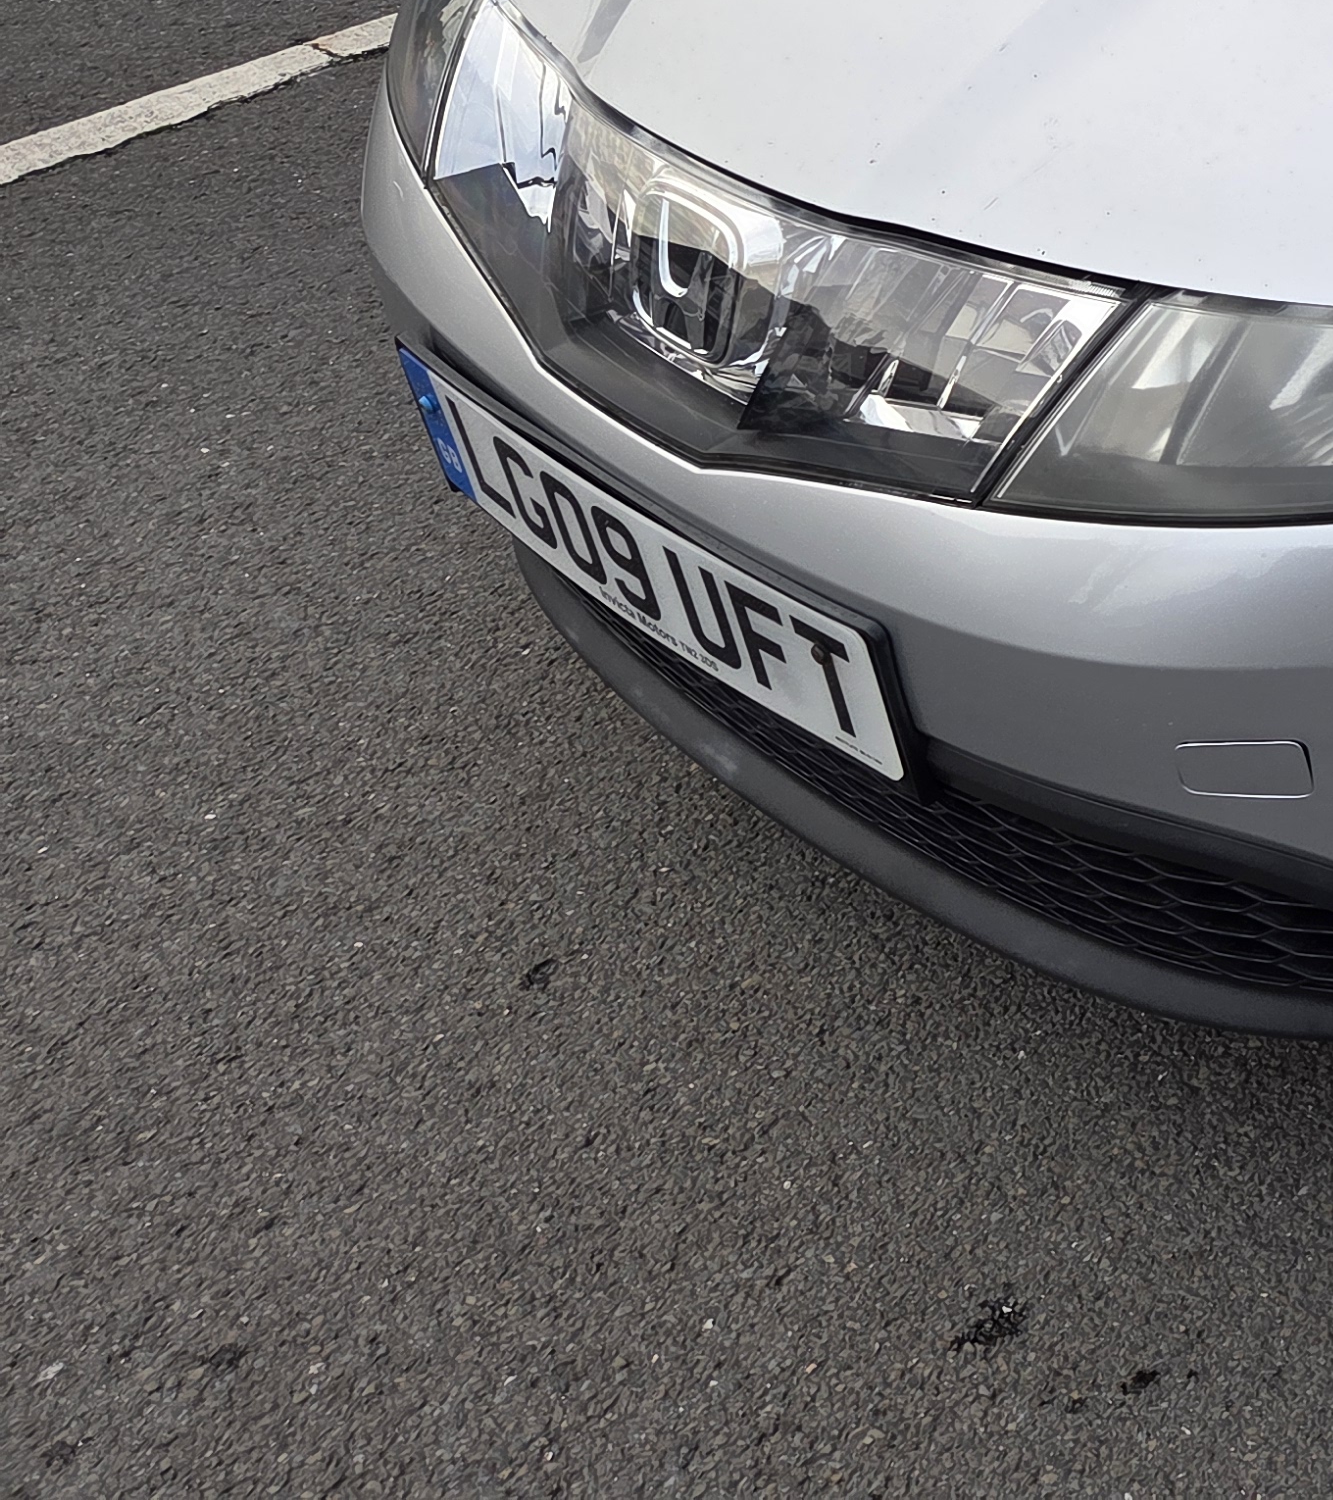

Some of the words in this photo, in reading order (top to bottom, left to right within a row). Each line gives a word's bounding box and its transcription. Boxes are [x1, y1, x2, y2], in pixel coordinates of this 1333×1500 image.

[436, 437, 463, 473] GB
[445, 394, 662, 621] LG09
[662, 544, 857, 739] UFT
[635, 611, 679, 647] Motors
